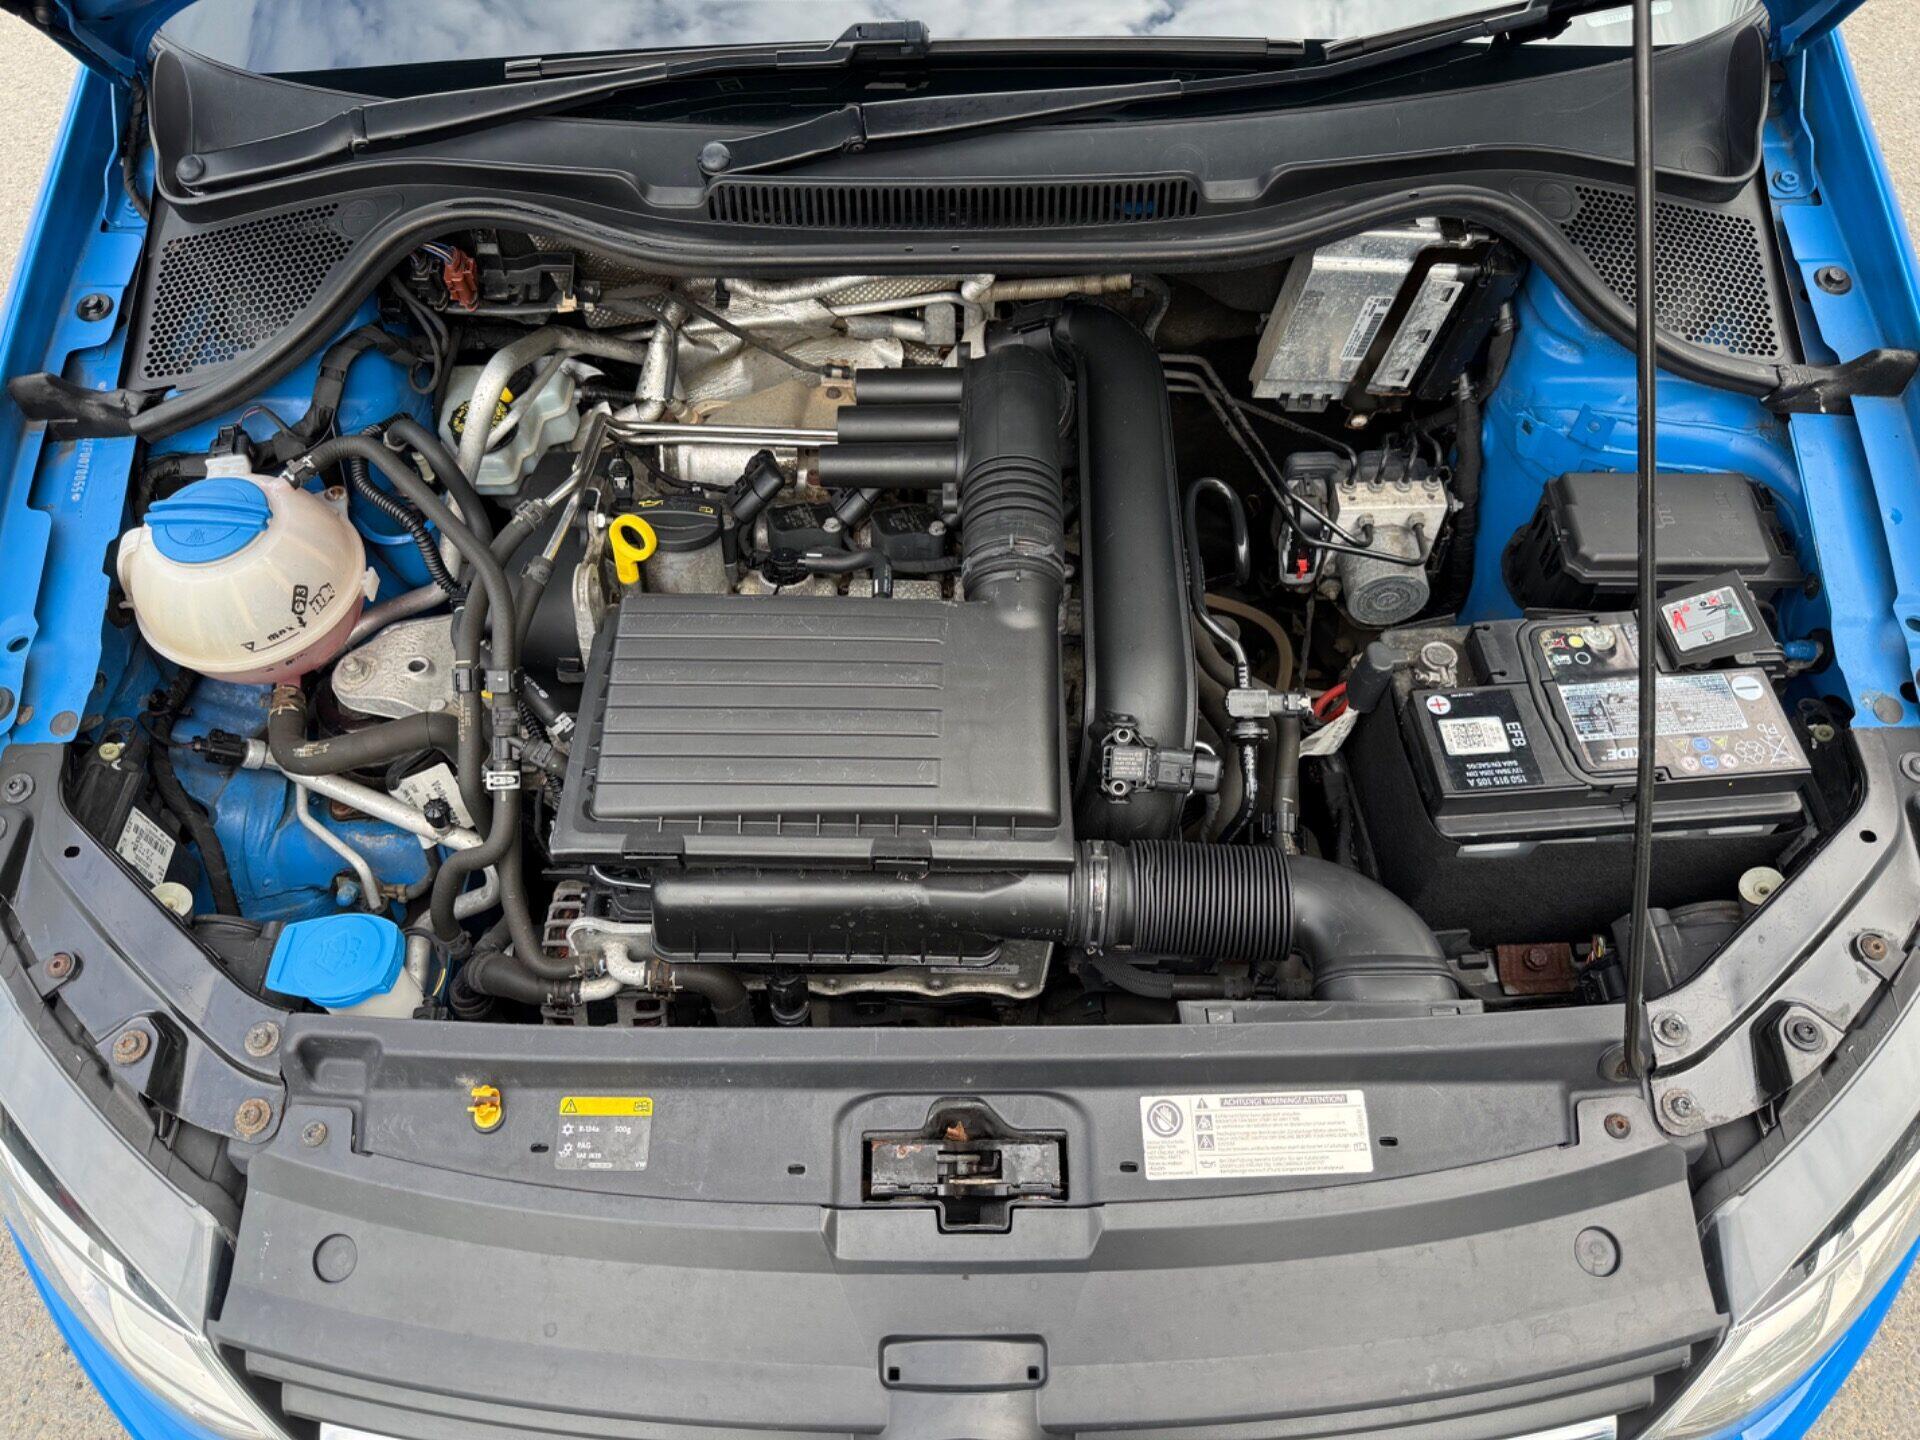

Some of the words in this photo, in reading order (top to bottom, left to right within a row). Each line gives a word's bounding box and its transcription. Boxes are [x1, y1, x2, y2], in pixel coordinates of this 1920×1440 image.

[292, 585, 308, 614] G13
[1505, 721, 1527, 747] EFB
[1757, 723, 1778, 735] Pb
[1467, 779, 1475, 787] A
[1477, 777, 1492, 787] 105
[1493, 776, 1509, 786] 915
[1264, 1096, 1301, 1105] WARNING!
[1302, 1094, 1346, 1104] ATTENTION!
